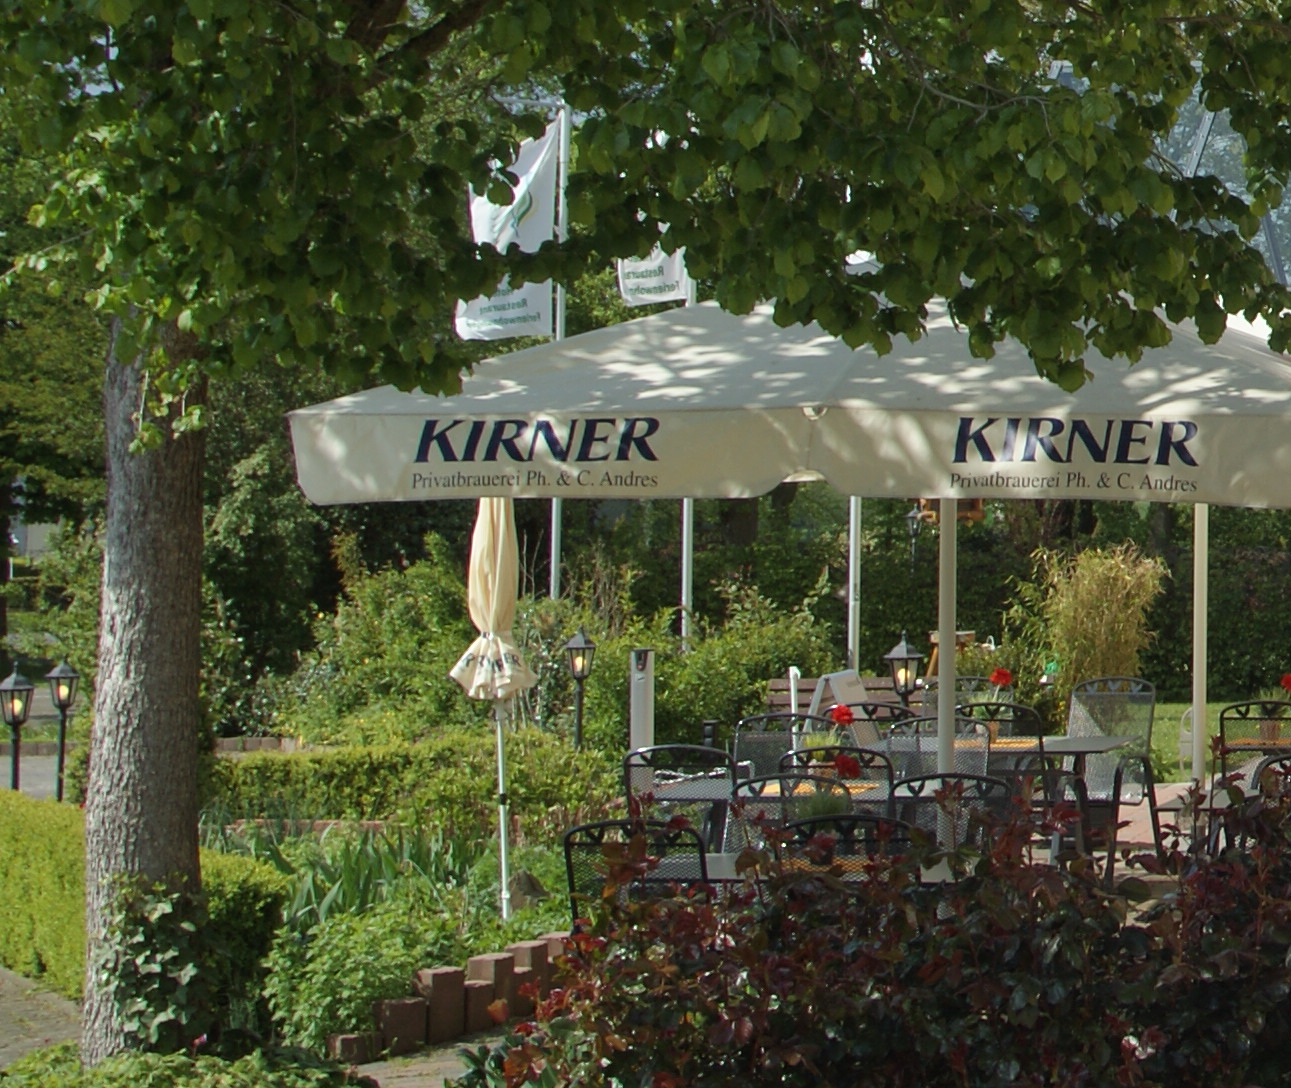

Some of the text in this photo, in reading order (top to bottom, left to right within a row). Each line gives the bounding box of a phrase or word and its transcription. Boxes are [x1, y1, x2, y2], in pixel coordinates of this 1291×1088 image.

[413, 417, 660, 463] KIRNER
[952, 416, 1199, 467] KIRNER
[412, 470, 658, 489] Privatbrauerei Ph. & C. Andres
[950, 472, 1198, 492] Privatbrauerei Ph. & C. Andres
